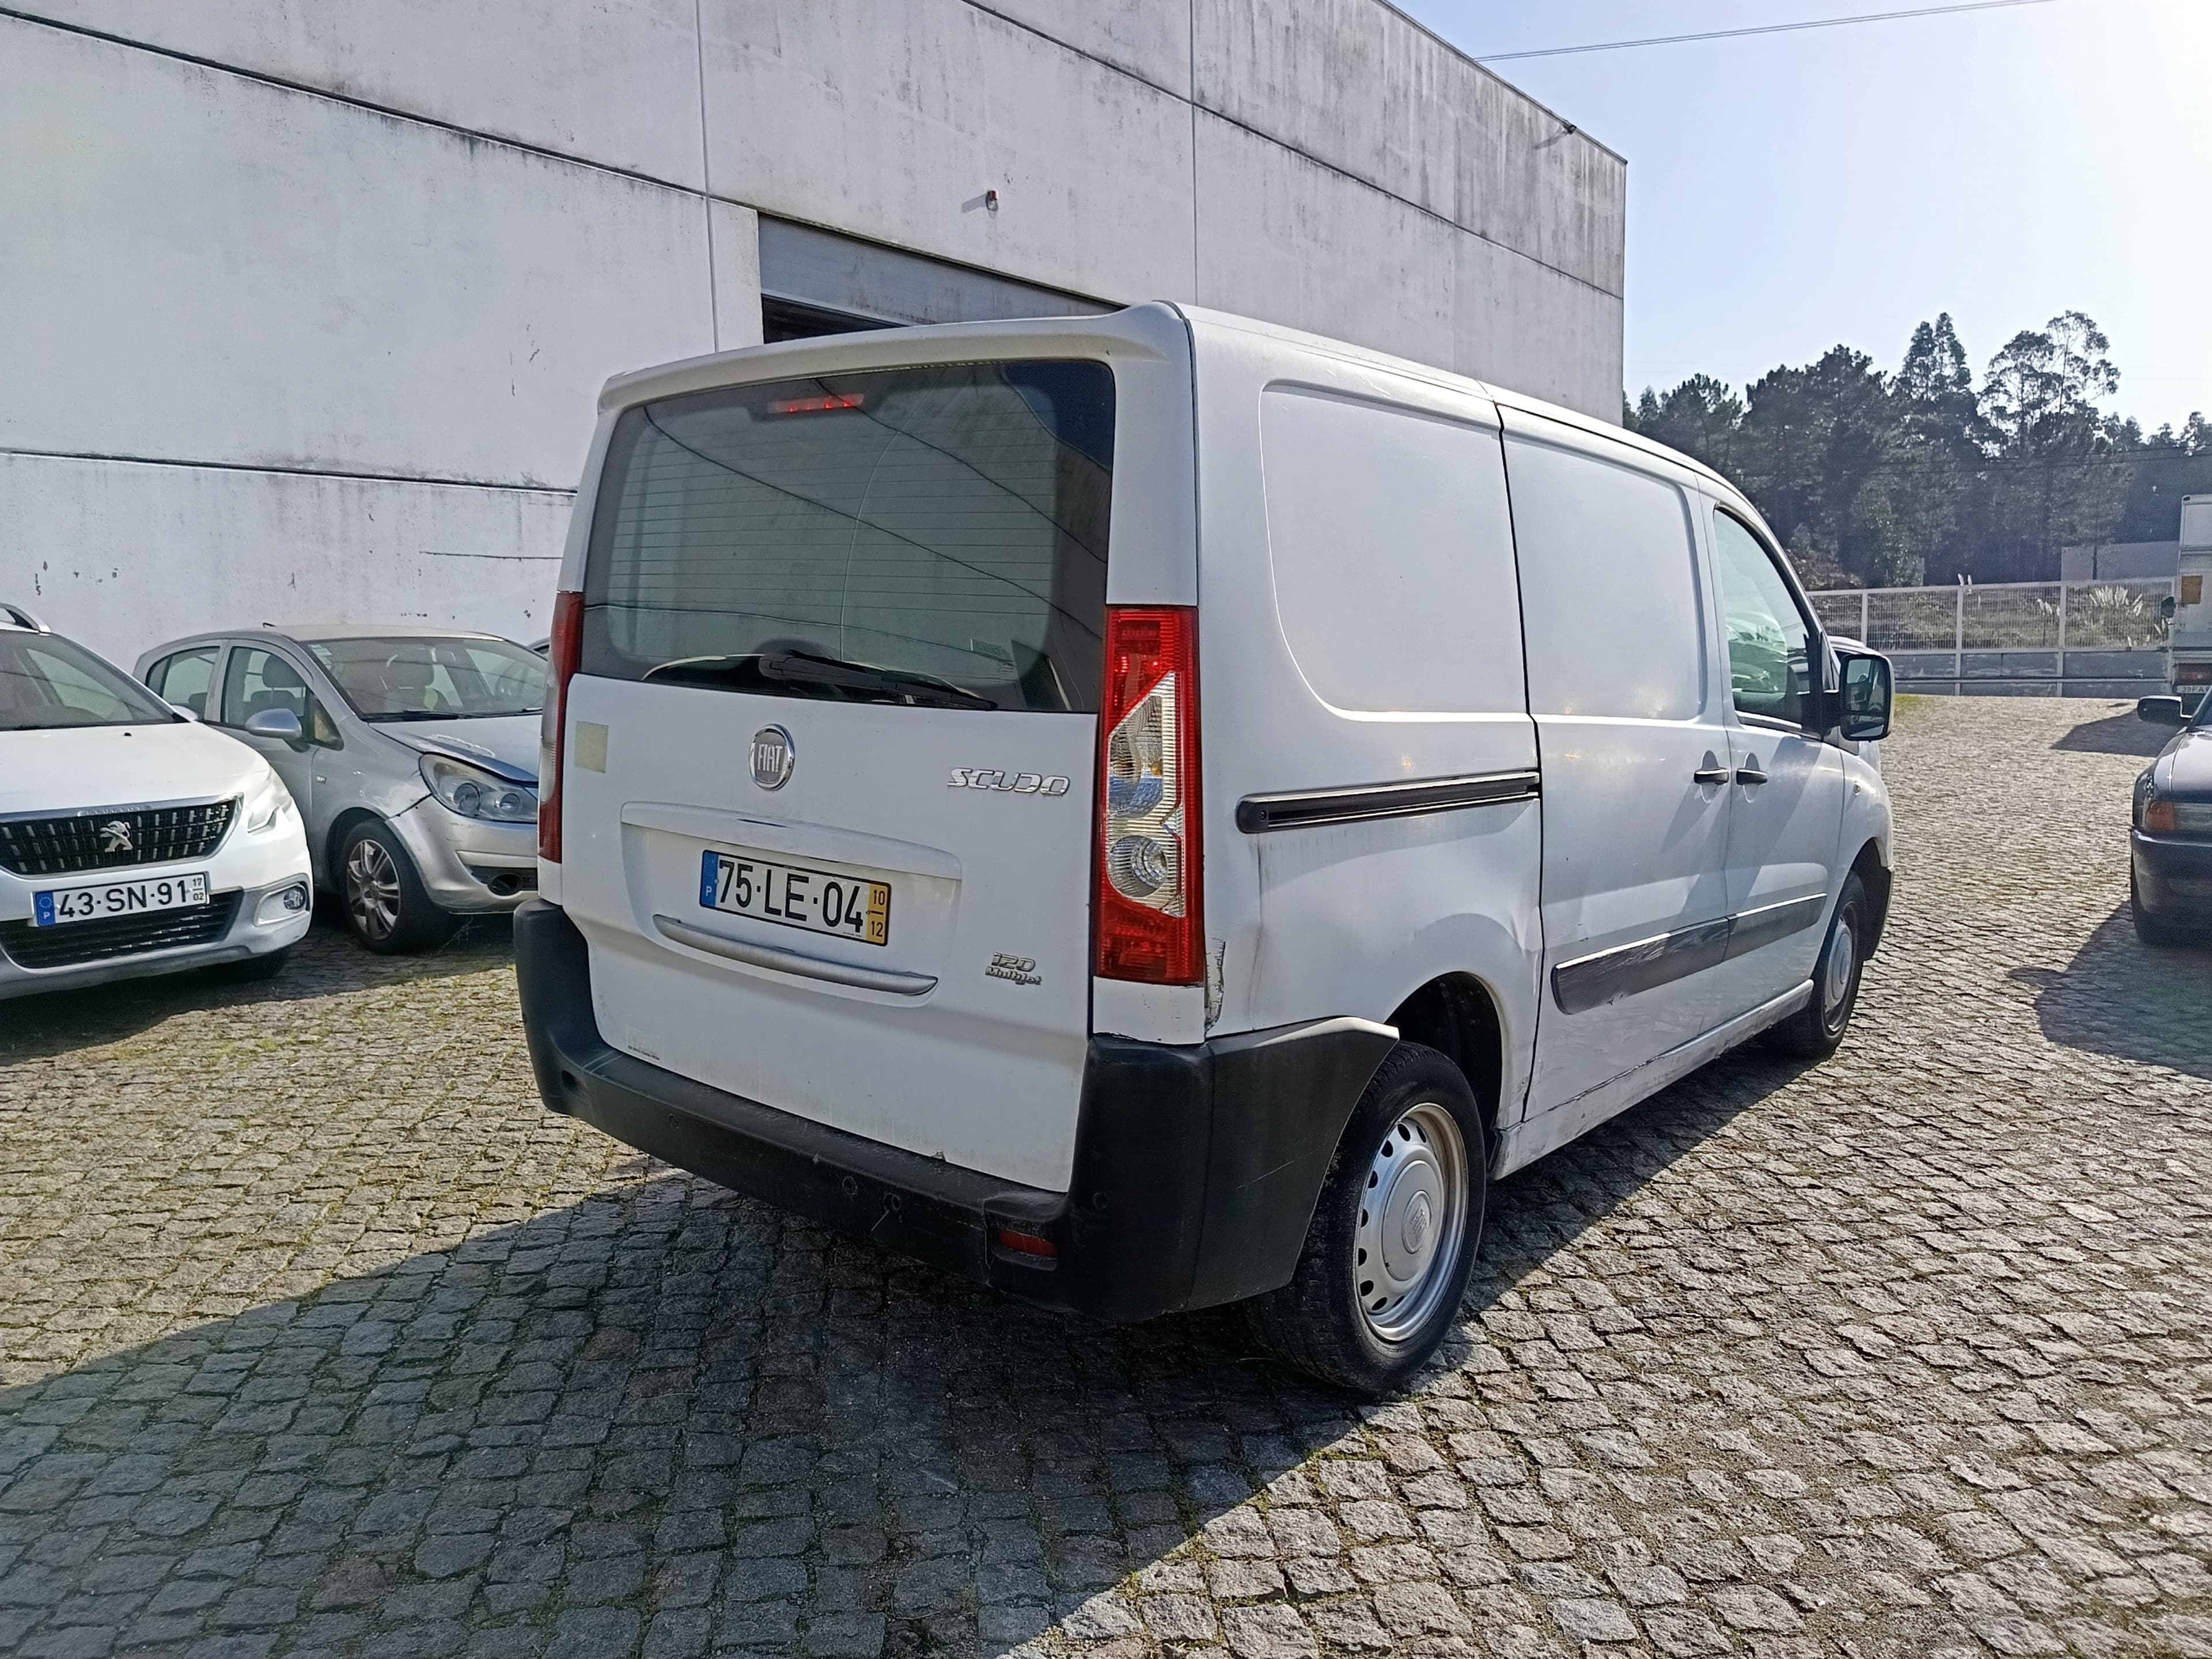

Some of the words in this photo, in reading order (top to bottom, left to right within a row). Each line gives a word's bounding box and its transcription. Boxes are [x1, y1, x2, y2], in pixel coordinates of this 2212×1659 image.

[757, 743, 783, 772] FIAT
[946, 767, 1070, 796] SCUDO
[192, 877, 202, 887] 17
[193, 892, 204, 902] 02
[706, 886, 713, 896] P
[873, 889, 885, 906] 10
[870, 921, 884, 937] 12
[991, 952, 1036, 972] 120
